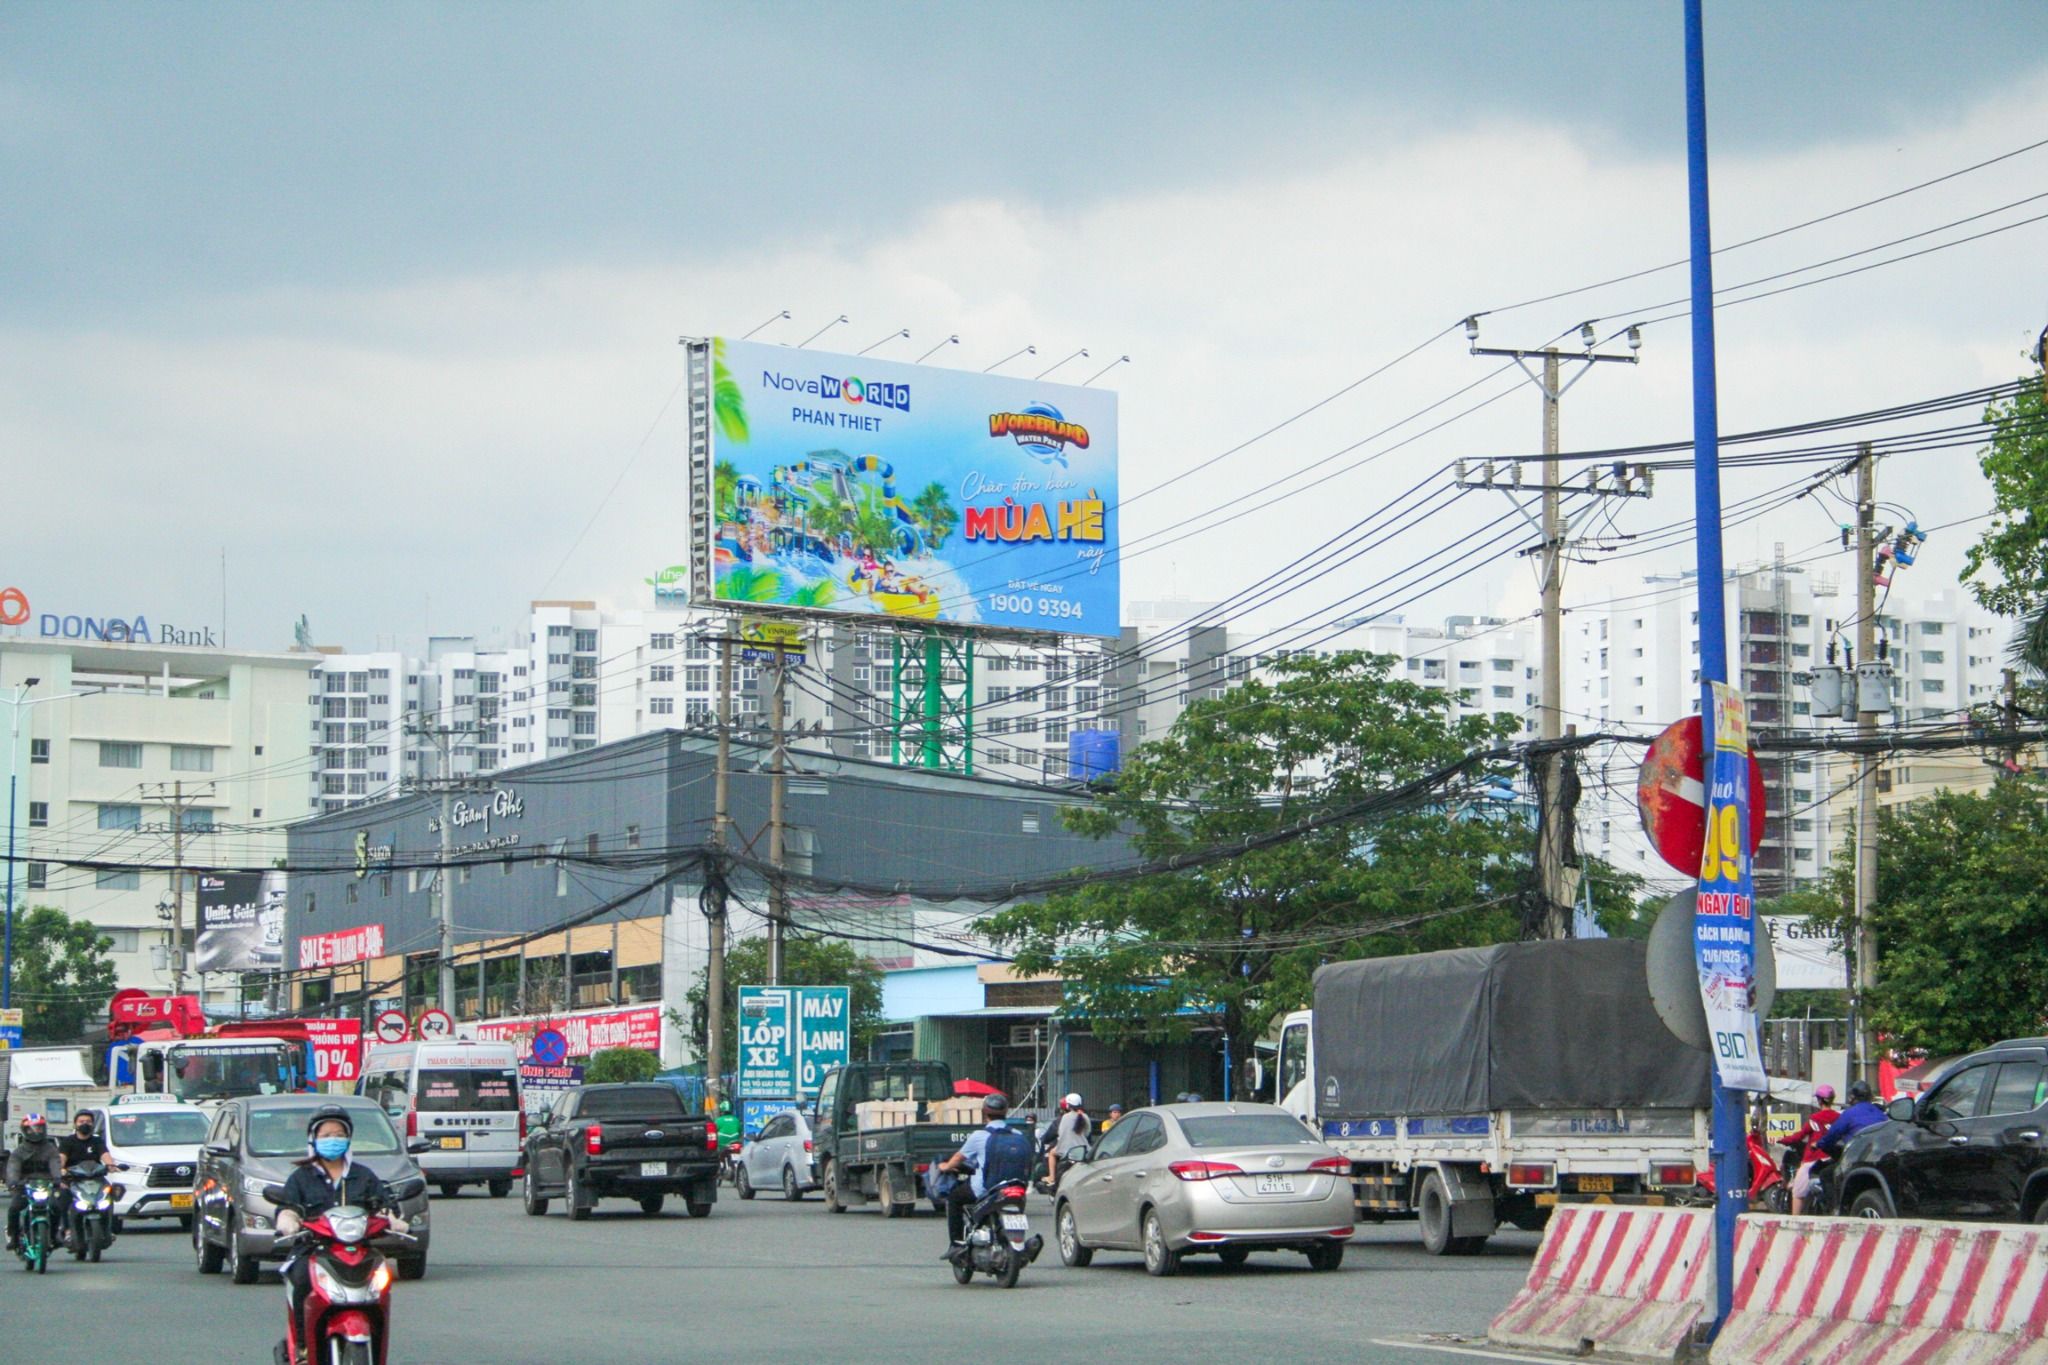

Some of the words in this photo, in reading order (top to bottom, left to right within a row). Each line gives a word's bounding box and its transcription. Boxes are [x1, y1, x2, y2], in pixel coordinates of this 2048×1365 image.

[792, 407, 835, 426] PHAN
[839, 413, 882, 432] THIET
[989, 412, 1090, 449] WONDERLAND
[965, 496, 1054, 542] MÙA
[1058, 488, 1105, 542] HÈ
[1040, 583, 1064, 594] NGAY
[989, 594, 1033, 614] 1900
[1038, 598, 1083, 620] 9394
[160, 624, 217, 648] Bank
[1696, 889, 1730, 916] NGÀY
[1697, 923, 1719, 941] CÁCH
[804, 994, 843, 1018] MÁY
[342, 1034, 358, 1045] VIP
[742, 1017, 785, 1045] LỐP
[803, 1031, 844, 1055] LẠNH
[748, 1047, 779, 1066] XE
[803, 1060, 816, 1083] Ô
